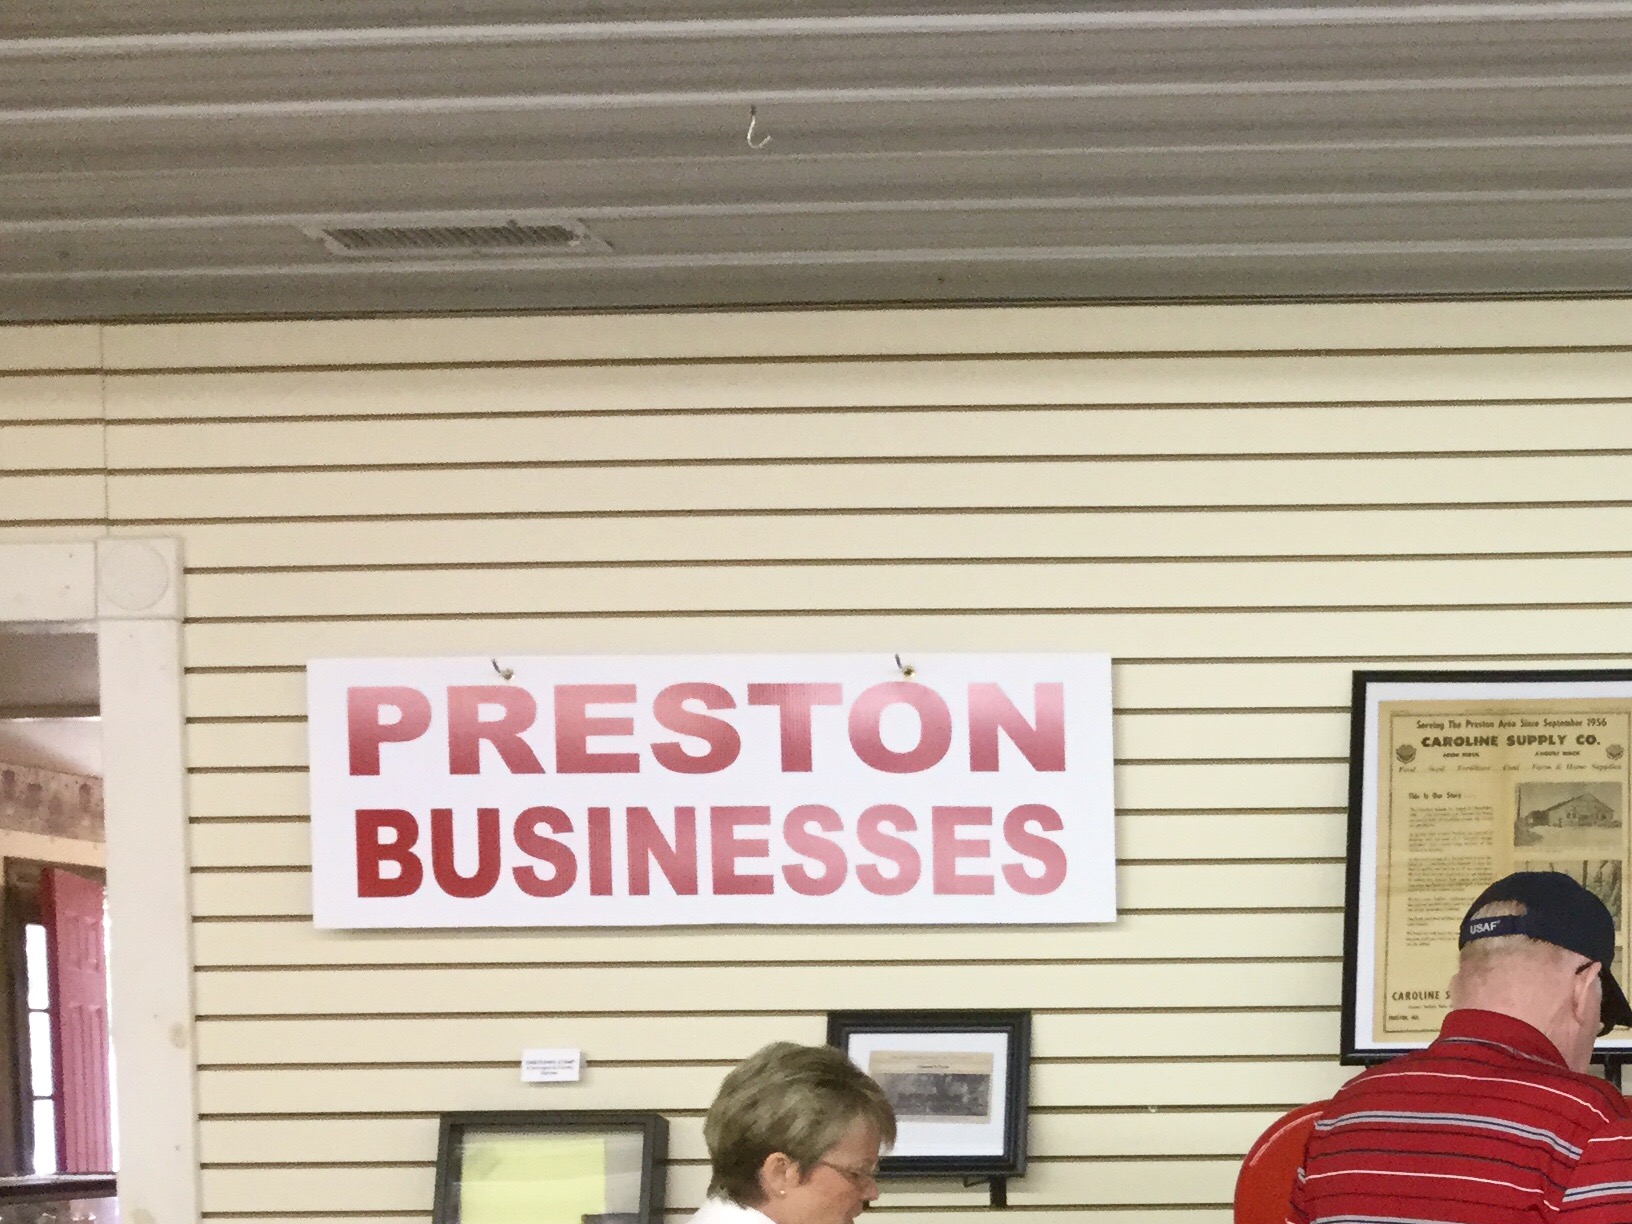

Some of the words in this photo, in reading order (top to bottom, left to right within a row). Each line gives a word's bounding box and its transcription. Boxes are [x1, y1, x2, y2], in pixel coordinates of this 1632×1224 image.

[346, 681, 1067, 776] PRESTON
[1416, 719, 1444, 731] Serving
[1449, 719, 1462, 729] The
[1466, 719, 1495, 729] Preston
[1543, 718, 1583, 729] September
[1587, 717, 1607, 727] 1956
[1421, 734, 1498, 748] CAROLINE
[1506, 734, 1567, 747] SUPPLY
[1576, 734, 1601, 746] CO.
[355, 803, 1068, 898] BUSINESSES
[1470, 921, 1498, 934] USAF
[1392, 991, 1439, 1001] CAROLINE
